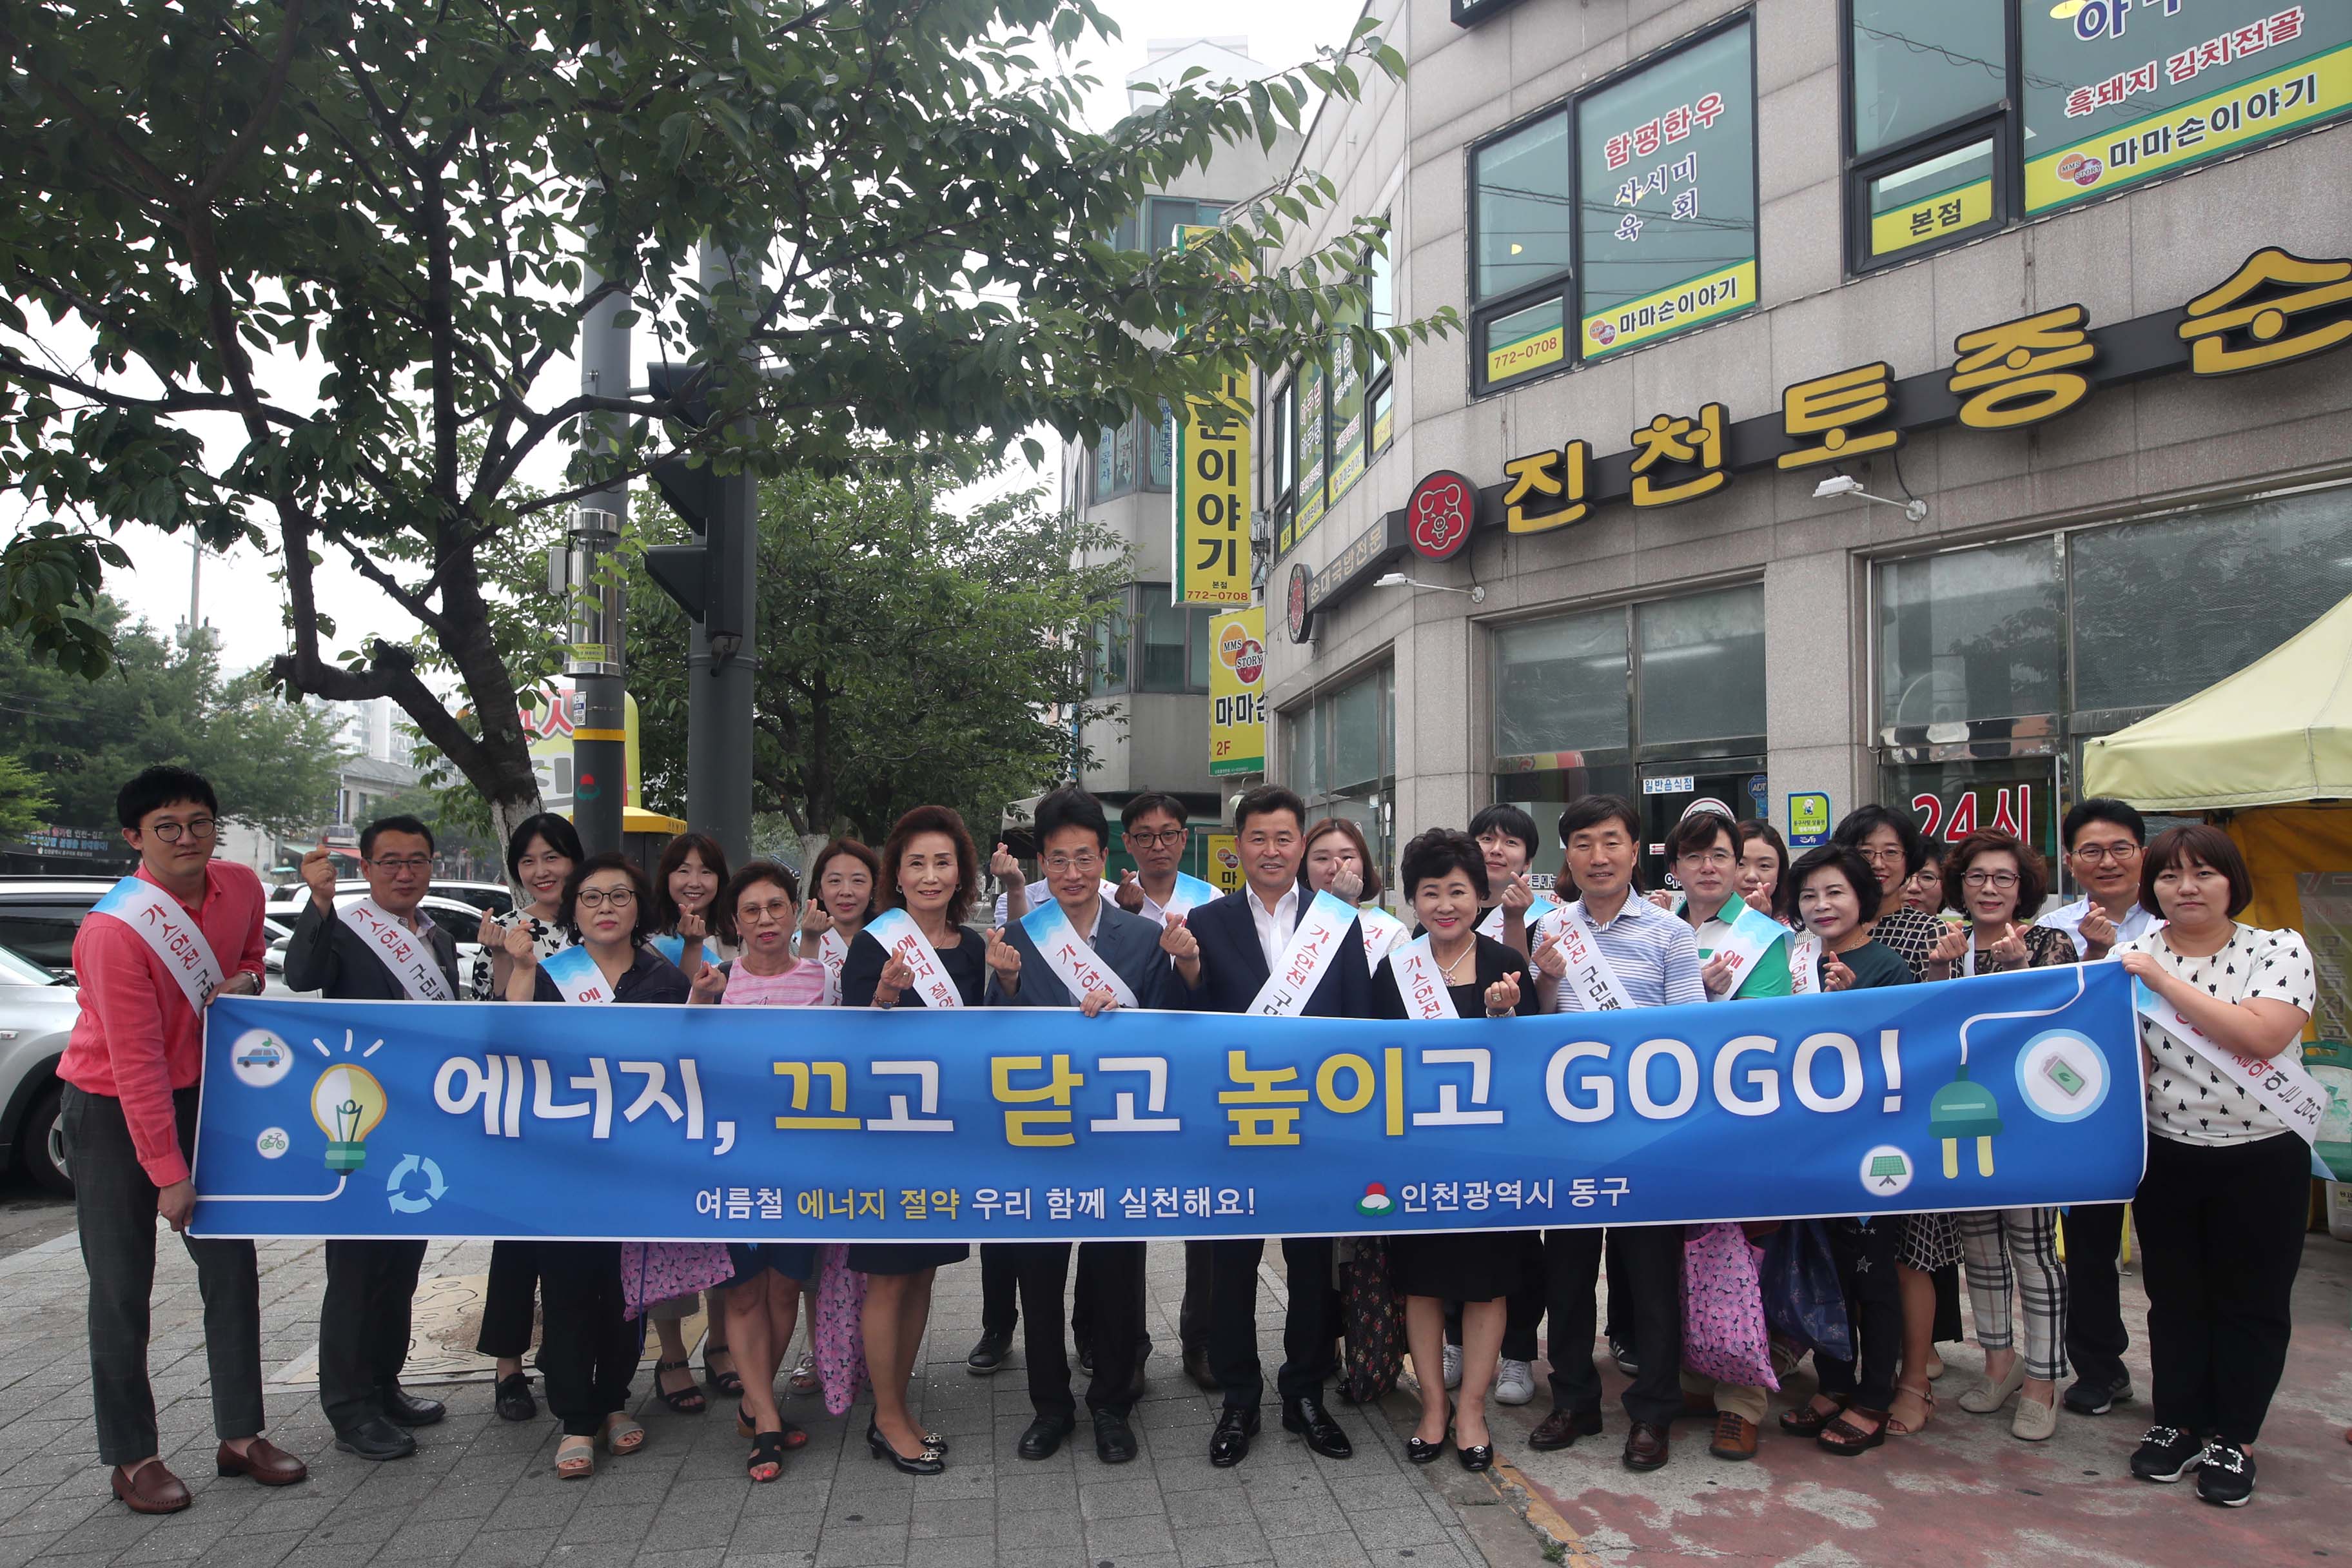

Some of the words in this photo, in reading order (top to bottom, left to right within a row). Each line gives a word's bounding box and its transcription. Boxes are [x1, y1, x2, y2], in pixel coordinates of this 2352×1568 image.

[2065, 61, 2157, 117] 흑돼지
[2166, 6, 2305, 86] 김치전골
[1605, 92, 1724, 170] 함평한우
[2110, 74, 2315, 168] 마마손이야기
[1614, 153, 1698, 206] 사시미
[2074, 164, 2102, 179] STORY
[1910, 199, 1962, 237] 본점
[1619, 277, 1738, 334] 마마손이야기
[1494, 337, 1557, 369] 772-0708
[1187, 591, 1248, 601] 772-0708
[1211, 581, 1228, 589] 본점
[1223, 640, 1242, 651] MMS
[1236, 655, 1263, 669] STORY
[1217, 740, 1231, 755] 2F
[1645, 779, 1692, 792] 일반음식점
[1752, 783, 1766, 792] ADT
[1912, 785, 2030, 847] 24시
[1527, 874, 1557, 888] 든메뉴
[141, 904, 201, 970] 가스안전
[351, 907, 414, 963] 가스안전
[897, 934, 934, 980] 에너지
[1286, 924, 1330, 990] 가스안전
[1403, 956, 1443, 1019] 가스안전
[433, 1054, 735, 1156] 에너지,
[774, 1059, 954, 1132] 끄고
[991, 1054, 1181, 1146] 닫고
[1219, 1047, 1503, 1146] 높이고
[1546, 1029, 1903, 1123] GOGO!
[695, 1187, 783, 1219] 여름철
[796, 1188, 885, 1220] 에너지
[899, 1188, 960, 1220] 절약
[972, 1188, 1032, 1220] 우리
[1046, 1187, 1106, 1219] 함께
[1119, 1187, 1255, 1218] 실천해요!
[1401, 1179, 1554, 1212] 인천광역시
[1568, 1177, 1631, 1207] 동구
